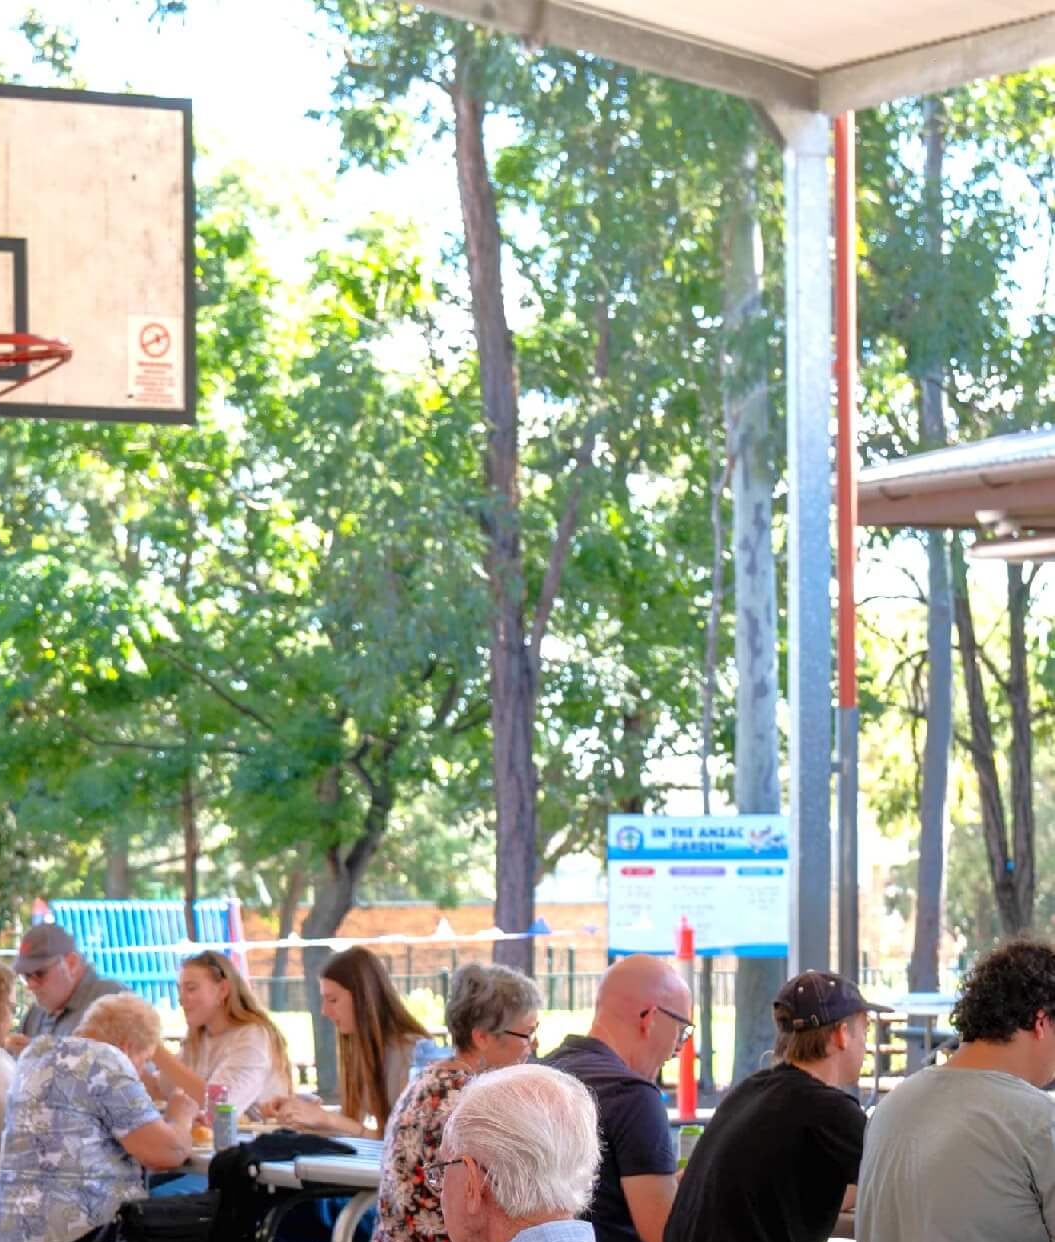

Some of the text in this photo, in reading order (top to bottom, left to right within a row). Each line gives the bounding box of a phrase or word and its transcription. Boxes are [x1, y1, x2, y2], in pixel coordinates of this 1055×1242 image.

[651, 826, 744, 838] IN THE ANZAC
